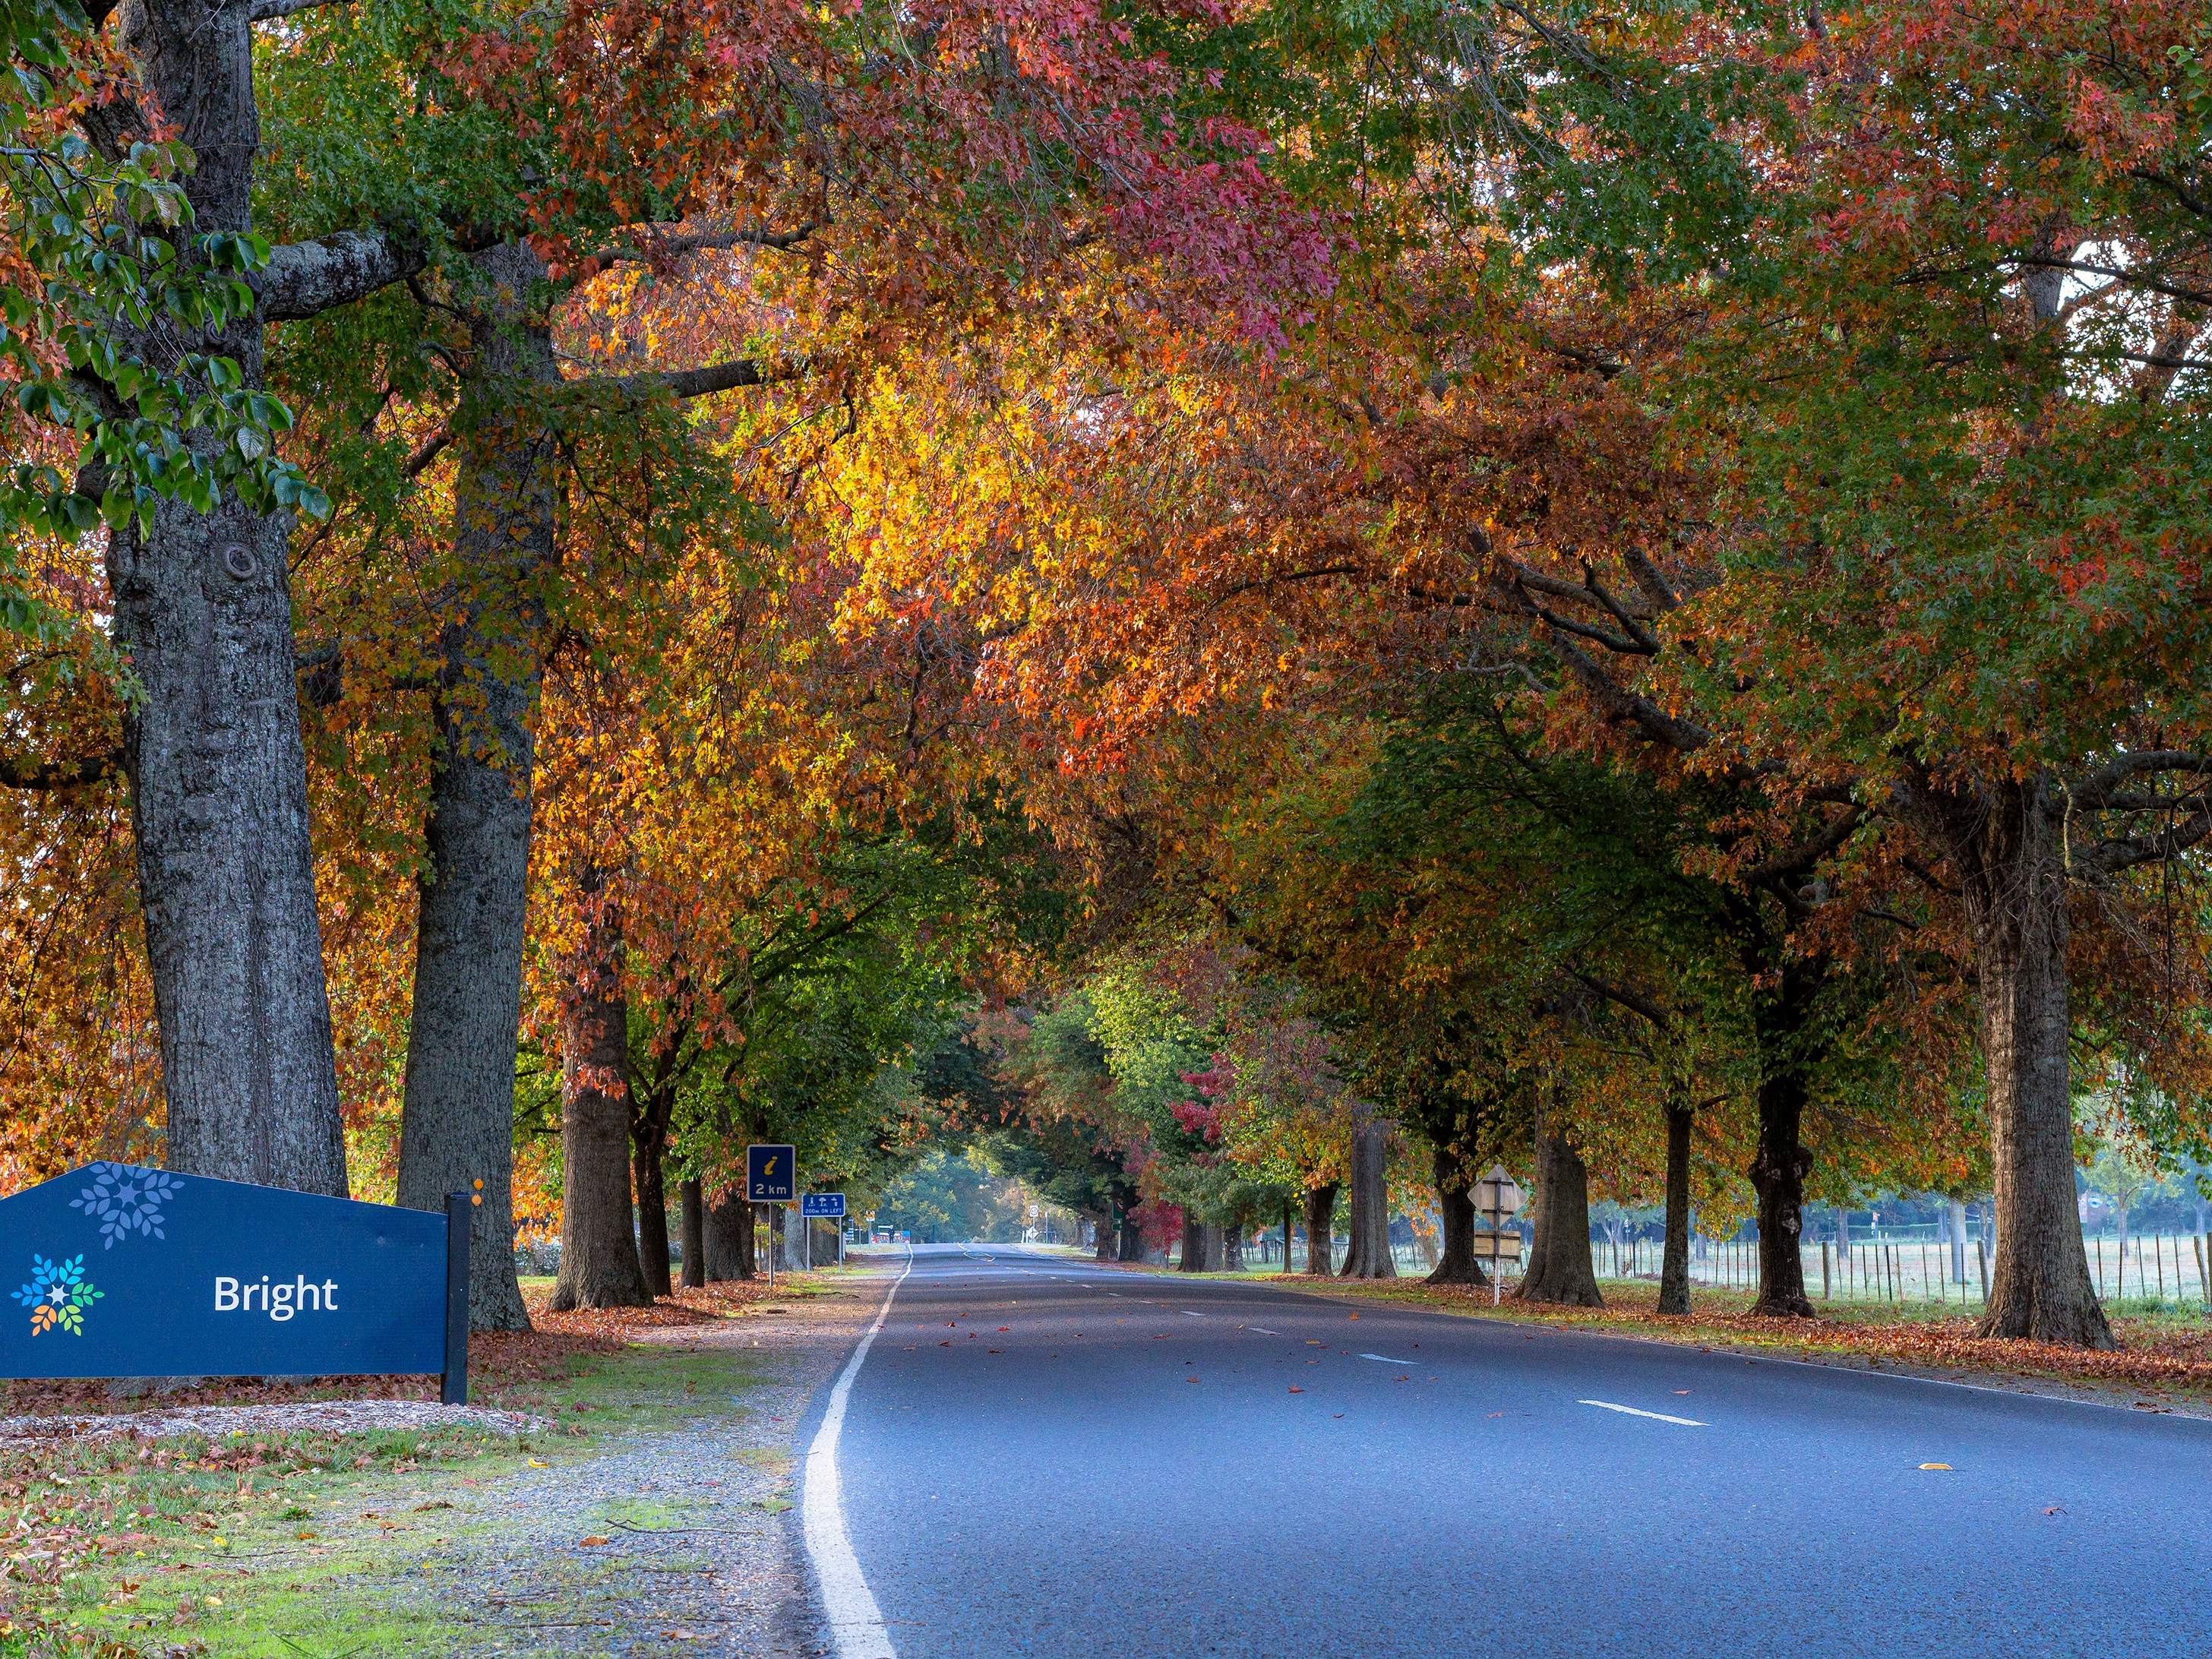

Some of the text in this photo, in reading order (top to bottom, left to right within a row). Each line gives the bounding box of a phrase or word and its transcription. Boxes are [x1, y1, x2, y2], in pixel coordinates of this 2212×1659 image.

[756, 1183, 786, 1194] 2 km
[215, 1275, 338, 1321] Bright
